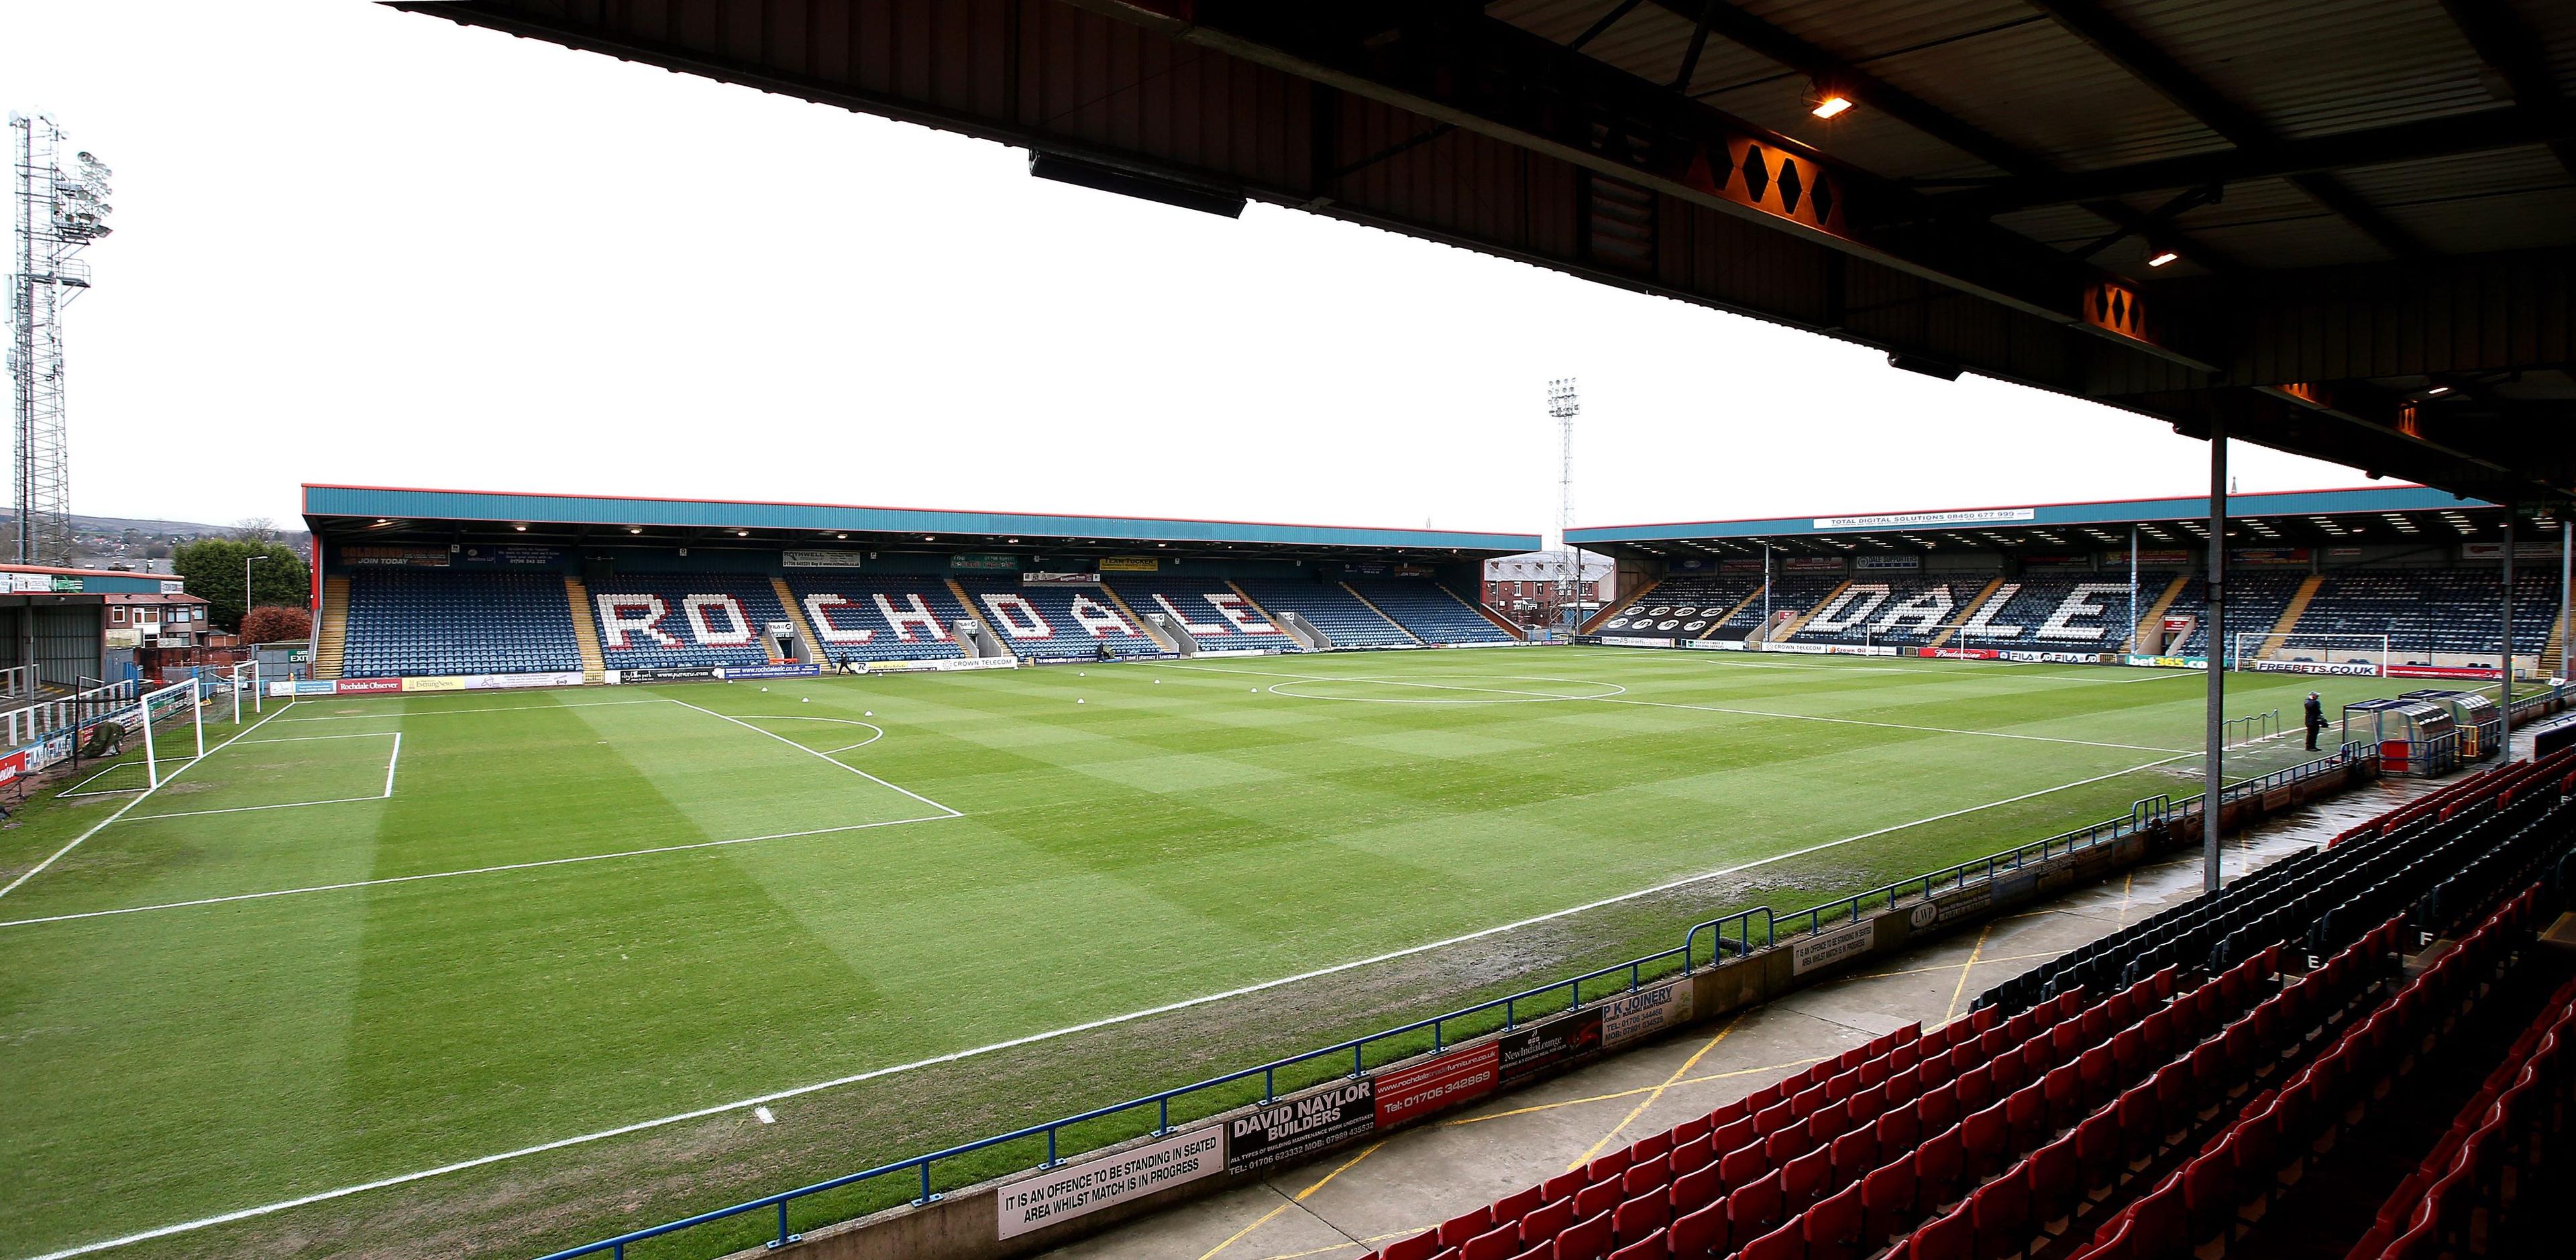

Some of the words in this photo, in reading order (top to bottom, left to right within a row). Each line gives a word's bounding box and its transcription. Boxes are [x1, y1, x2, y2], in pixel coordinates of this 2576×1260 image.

[596, 594, 1280, 650] ROCHDALE
[1807, 583, 2139, 640] DALE
[2011, 652, 2034, 661] FILA
[2054, 654, 2078, 663] FILA
[2129, 656, 2208, 669] bet365.co
[2259, 663, 2374, 675] FREEBETS.CO.UK
[340, 682, 369, 691] Rochdale
[369, 681, 398, 689] Observer
[1915, 907, 1933, 923] LWP
[1810, 941, 1827, 954] OFFENCE
[1837, 932, 1854, 944] STANDING
[1859, 926, 1872, 937] SEATED
[1825, 948, 1839, 958] MATCH
[1847, 939, 1866, 950] PROGRESS
[2420, 932, 2433, 946] F
[2308, 955, 2320, 969] E
[1603, 1006, 1610, 1019] P
[1614, 1002, 1622, 1015] K
[1625, 985, 1673, 1011] JOINERY
[1622, 1007, 1642, 1017] BUILDING
[1644, 997, 1672, 1011] MAINTENANCE
[1606, 1023, 1621, 1032] TEL:
[1621, 1015, 1640, 1027] 01706
[1605, 1031, 1622, 1041] MOB:
[1377, 1051, 1496, 1094] www.rochdaletradefurniture.co.uk
[1499, 1061, 1518, 1071] OFFERING
[1385, 1101, 1403, 1114] Tel:
[1404, 1087, 1444, 1108] 01706
[1445, 1071, 1491, 1094] 342869
[1234, 1106, 1293, 1138] DAVID
[1297, 1082, 1371, 1119] NAYLOR
[1242, 1149, 1258, 1160] TYPES
[1267, 1139, 1291, 1152] BUILDING
[1292, 1128, 1328, 1144] MAINTENANCE
[1328, 1124, 1343, 1133] WORK
[1343, 1112, 1374, 1127] UNDERTAKEN
[1269, 1107, 1341, 1141] BUILDERS
[1229, 1165, 1248, 1175] TEL:
[1249, 1156, 1273, 1169] 01706
[1275, 1146, 1303, 1161] 623332
[1305, 1139, 1325, 1151] MOB:
[1326, 1131, 1348, 1144] 07989
[1349, 1122, 1375, 1137] 435532
[1006, 1196, 1015, 1211] IT
[1018, 1192, 1028, 1208] IS
[1030, 1188, 1044, 1204] AN
[1046, 1173, 1092, 1199] OFFENCE
[1094, 1169, 1108, 1184] TO
[1110, 1165, 1122, 1180] BE
[1124, 1150, 1170, 1176] STANDING
[1173, 1147, 1182, 1161] IN
[1184, 1136, 1217, 1157] SEATED
[1024, 1206, 1051, 1224] AREA
[1053, 1190, 1089, 1214] WHILST
[1091, 1180, 1125, 1202] MATCH
[1126, 1176, 1136, 1192] IS
[1138, 1173, 1148, 1188] IN
[1150, 1157, 1199, 1184] PROGRESS
